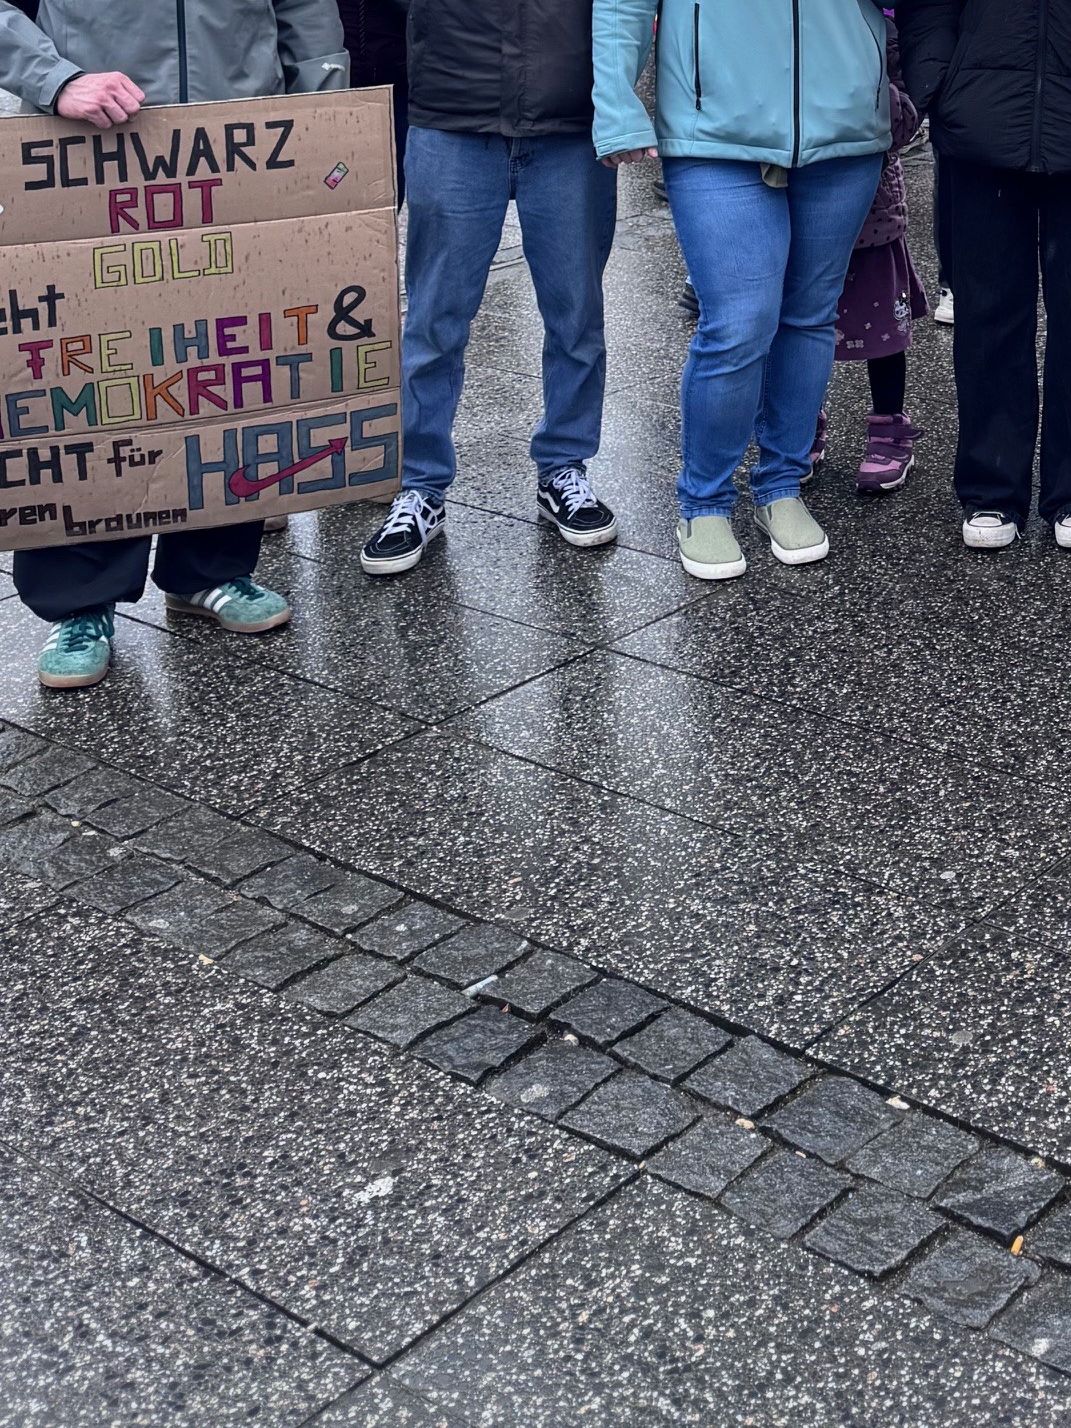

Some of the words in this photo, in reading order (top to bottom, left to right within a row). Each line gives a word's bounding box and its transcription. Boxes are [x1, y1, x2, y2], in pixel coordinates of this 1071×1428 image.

[20, 119, 295, 191] SCHWARZ
[108, 178, 223, 233] ROT
[92, 231, 234, 289] GOLD
[18, 304, 319, 380] FREIHEIT
[326, 285, 377, 342] &
[0, 340, 392, 440] EMOKRATIE
[106, 438, 163, 478] für
[184, 402, 399, 511] HASS
[62, 504, 188, 537] braunen
